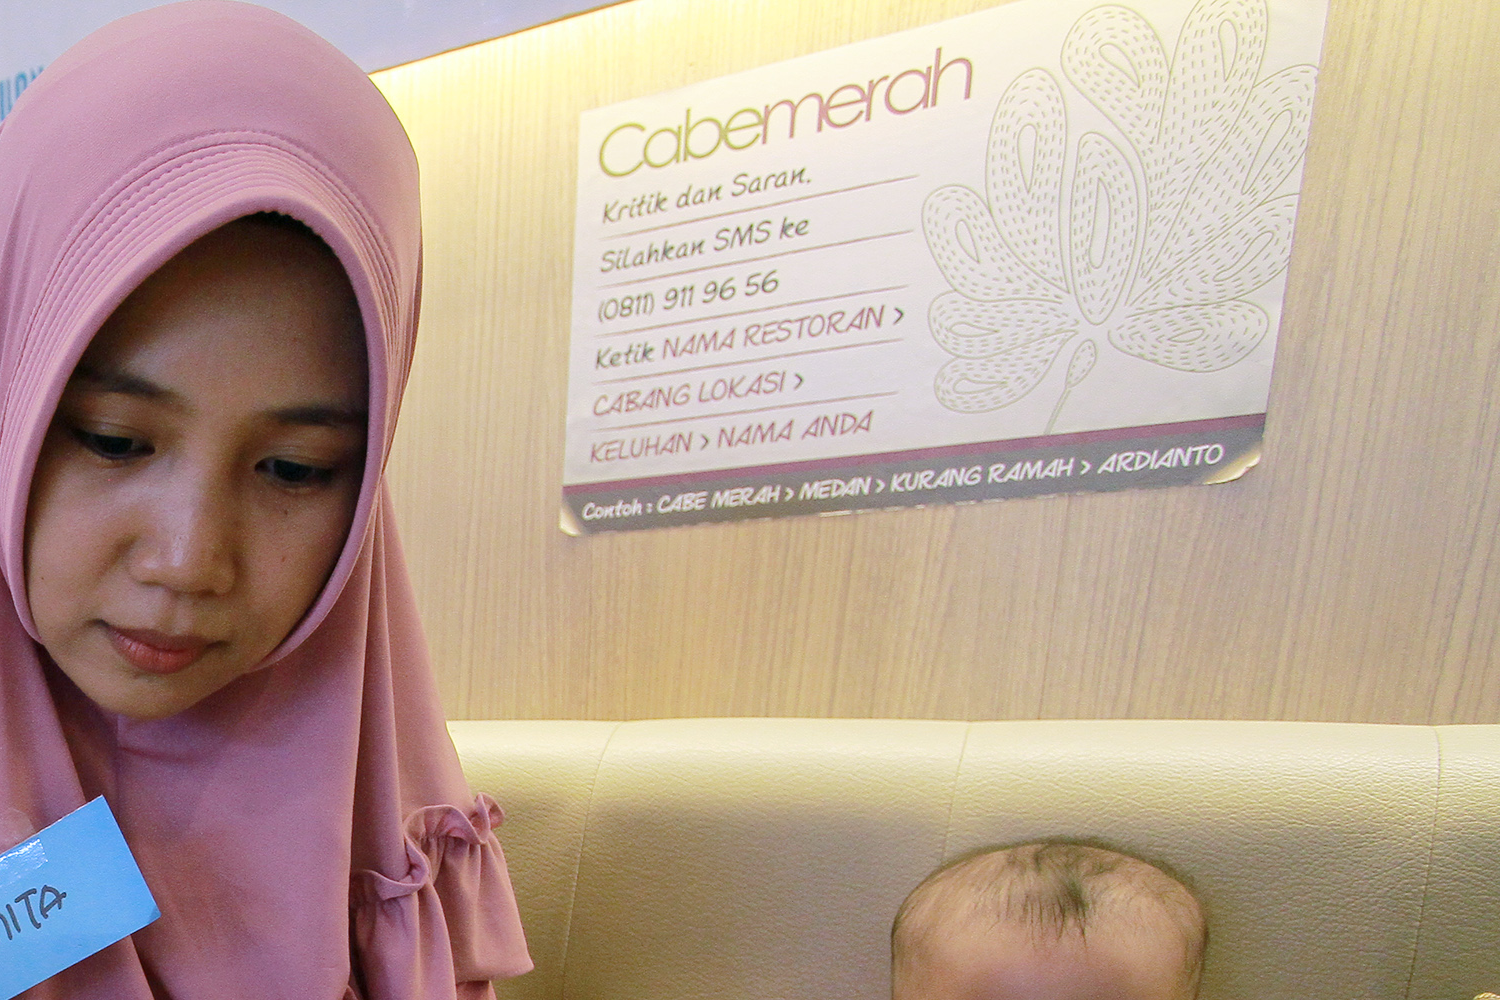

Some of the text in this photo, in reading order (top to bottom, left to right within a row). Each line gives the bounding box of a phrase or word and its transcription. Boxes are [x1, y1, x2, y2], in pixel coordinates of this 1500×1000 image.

[599, 46, 973, 177] Cabemerah
[602, 167, 812, 223] Kritik dan Saran.
[600, 217, 810, 273] Silahkan SMS ke
[598, 269, 780, 322] (0811) 911 96 56
[595, 342, 655, 369] Ketik
[662, 328, 736, 360] NAMA
[743, 304, 886, 347] RESTORAN
[592, 383, 691, 417] CABANG
[698, 371, 786, 403] LOKASI
[590, 431, 694, 463] KELUHAN
[717, 419, 795, 449] NAMA
[801, 409, 874, 440] ANDA
[581, 498, 642, 521] Contoh
[656, 491, 707, 514] CABE
[710, 484, 781, 509] MERAH
[799, 476, 872, 500] MEDAN
[889, 464, 983, 493] KURANG
[987, 456, 1074, 484] RAMAH
[1096, 443, 1226, 475] ARDIANTO
